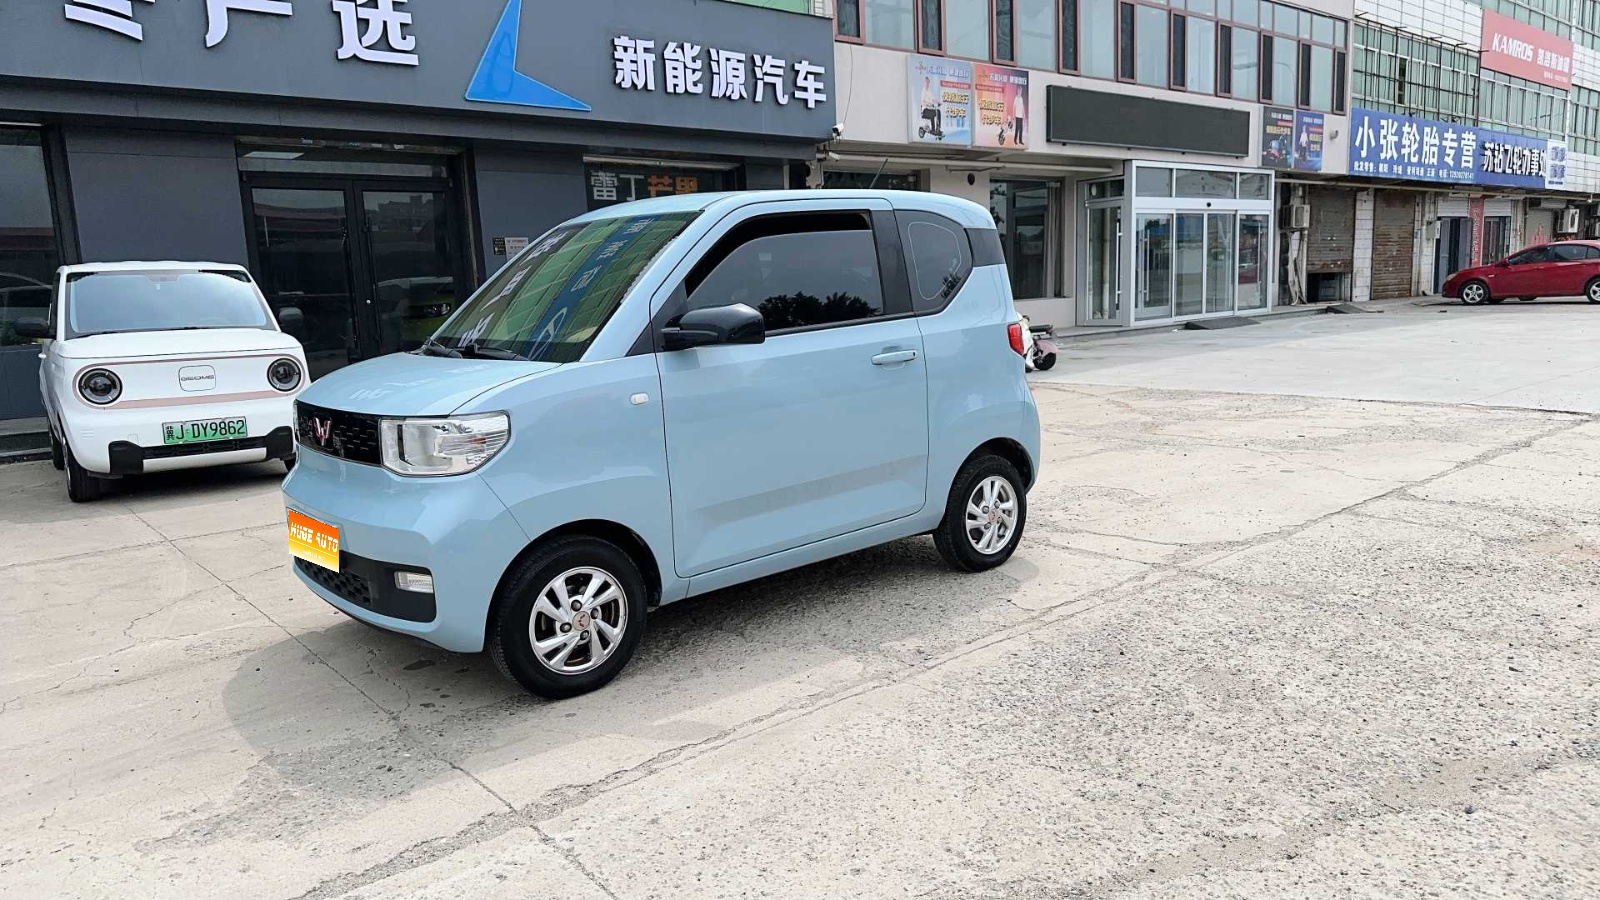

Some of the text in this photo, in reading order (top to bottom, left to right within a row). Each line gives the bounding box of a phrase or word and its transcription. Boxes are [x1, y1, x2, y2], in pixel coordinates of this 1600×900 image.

[613, 35, 827, 109] 新能源汽车
[1492, 33, 1534, 62] KAMROS
[1355, 116, 1476, 169] 小张轮胎专营
